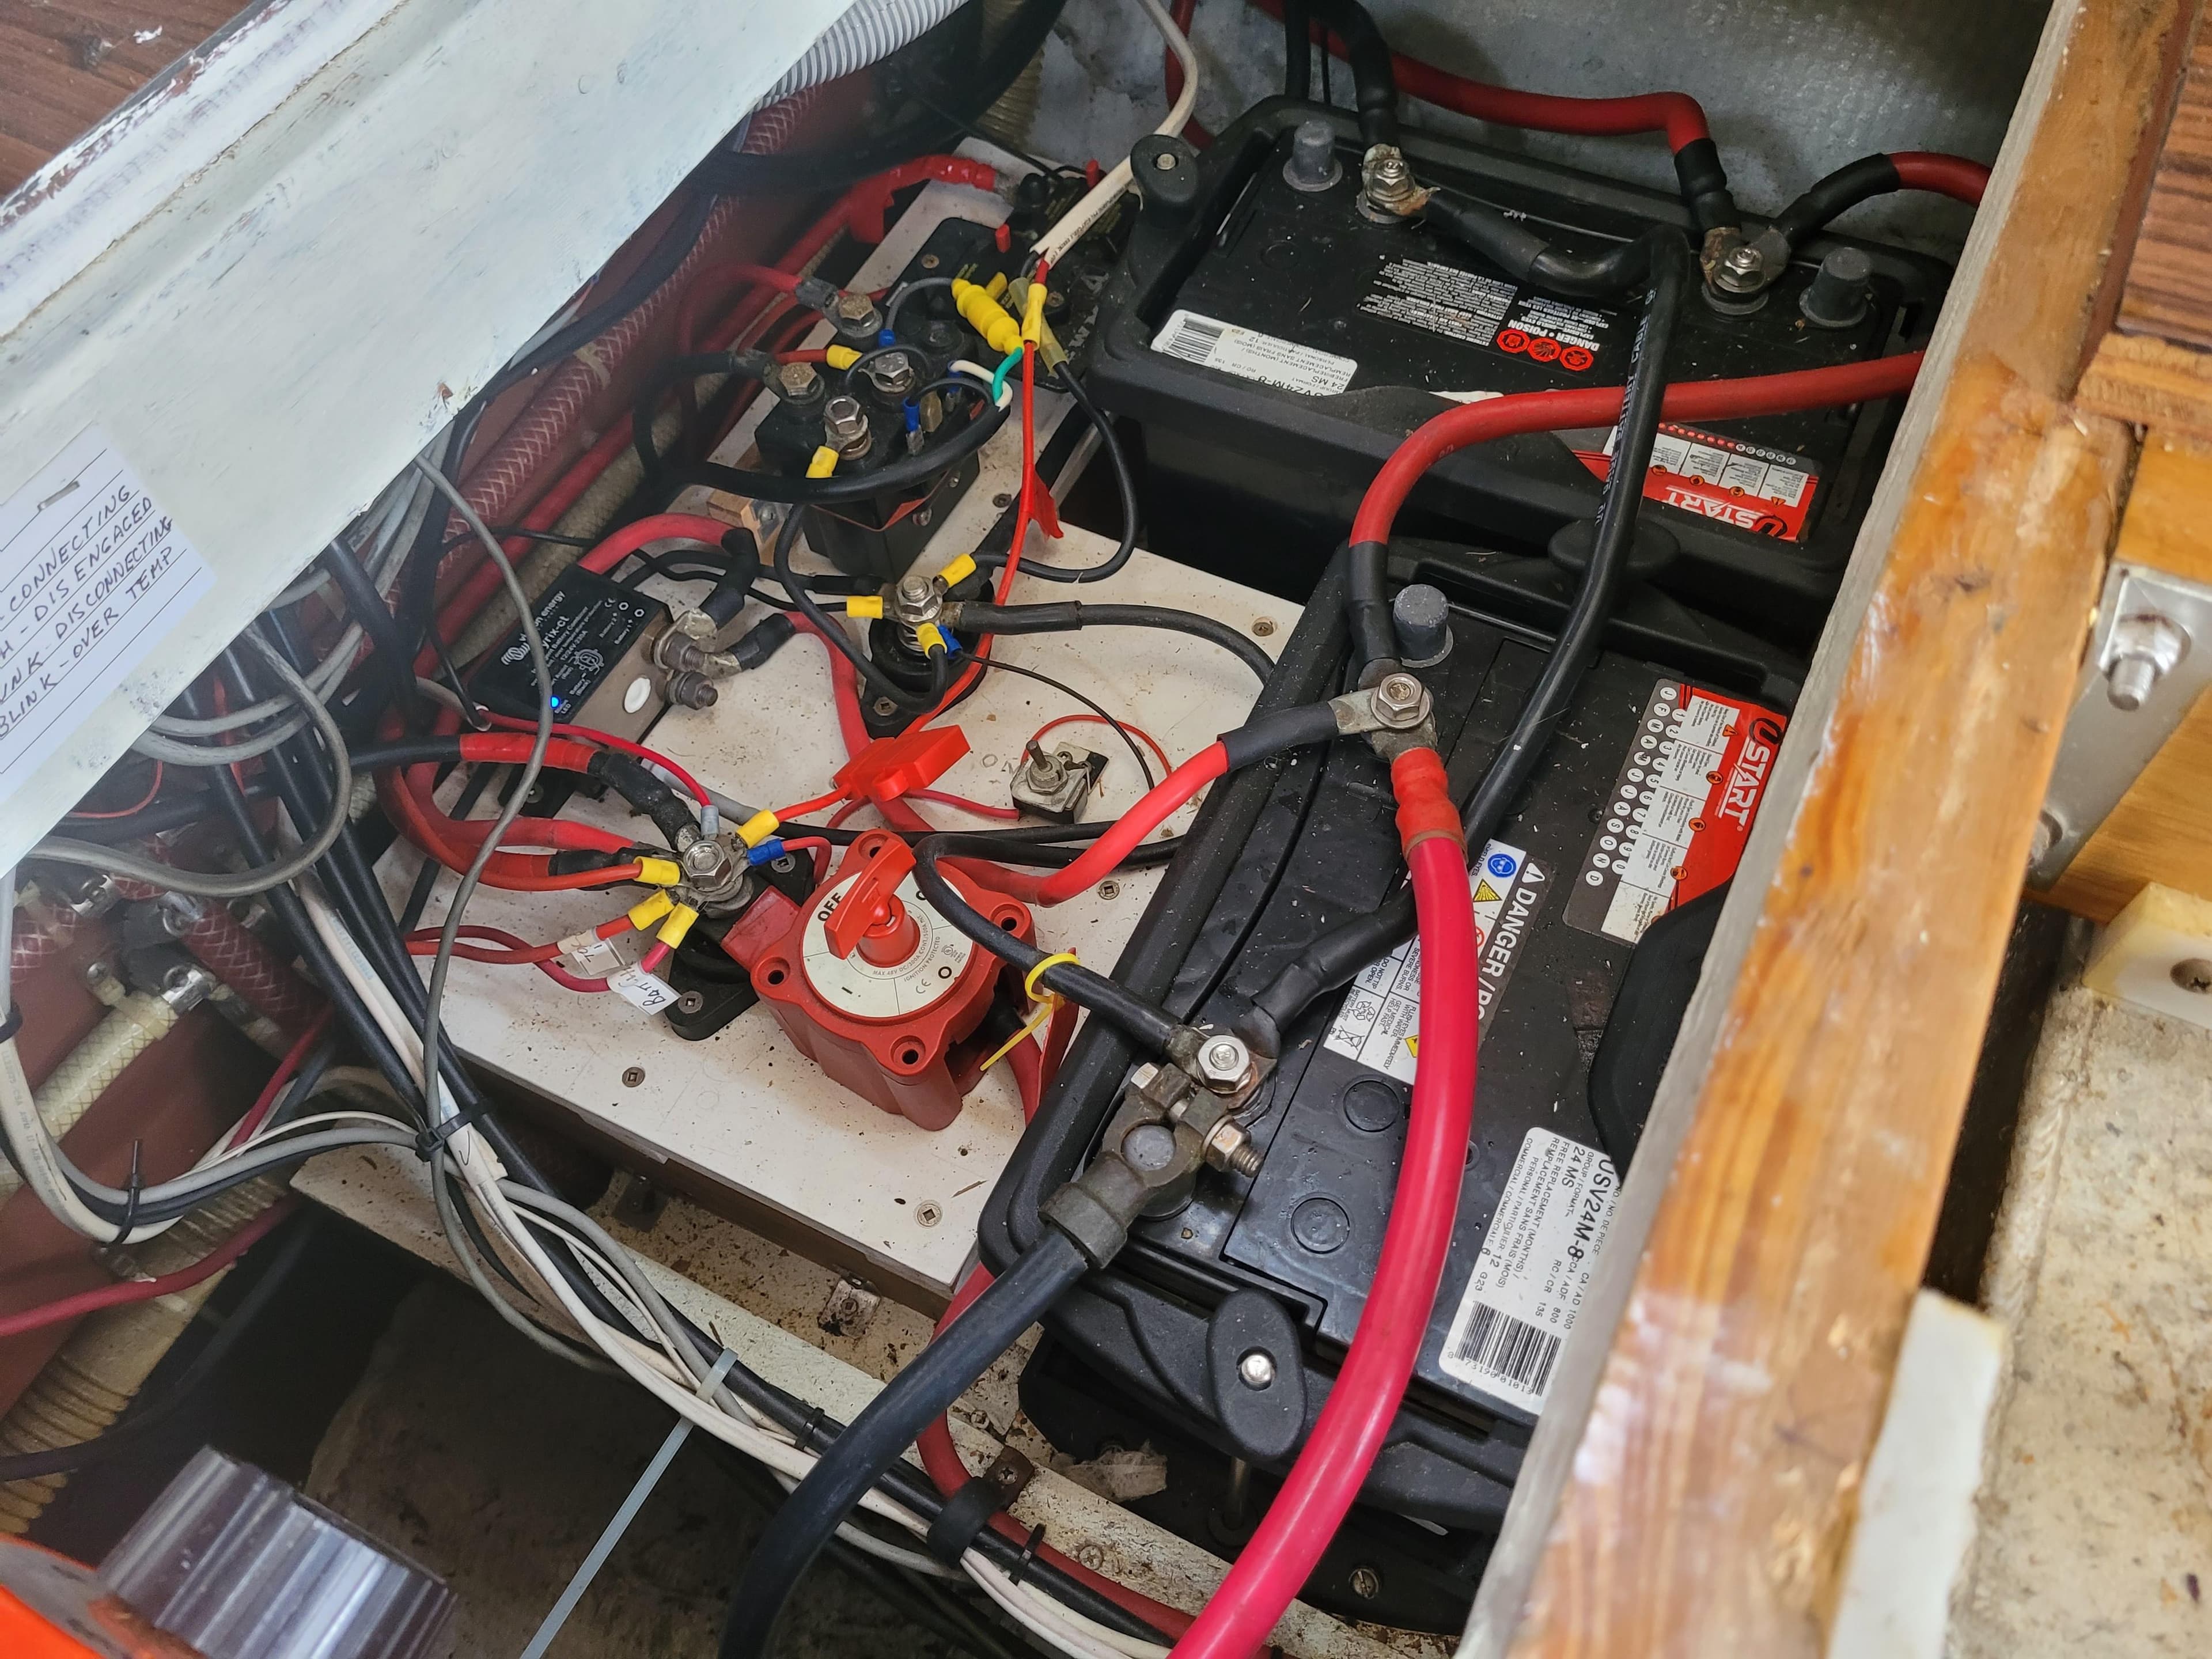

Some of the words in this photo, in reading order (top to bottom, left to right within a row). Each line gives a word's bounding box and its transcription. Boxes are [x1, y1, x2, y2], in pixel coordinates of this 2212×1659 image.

[1508, 319, 1547, 336] POISON
[1630, 314, 1648, 363] CABLE
[1556, 332, 1599, 351] DANGER
[1310, 375, 1328, 385] MS
[1331, 381, 1344, 389] 24
[2, 483, 131, 612] CONNECTING
[51, 514, 175, 638] DISCONNECTING
[31, 580, 71, 621] DIS
[68, 606, 119, 657] OVER
[124, 545, 178, 599] TEMP
[540, 590, 565, 618] energy
[539, 613, 570, 649] yrix-ct
[817, 892, 842, 921] OFF
[1480, 886, 1539, 978] DANGER
[904, 963, 927, 982] IGNITION
[925, 935, 941, 964] PROTECTED
[1380, 957, 1388, 967] DO
[1404, 946, 1420, 971] SEVERE
[1365, 966, 1377, 984] OPEN.
[1370, 979, 1378, 989] TIP
[1374, 967, 1384, 980] NOT
[1395, 969, 1410, 991] BURNS.
[1403, 982, 1411, 991] OR
[1385, 998, 1396, 1012] HELP
[1392, 1000, 1402, 1011] GET
[1400, 1003, 1410, 1018] WITH
[1403, 1006, 1416, 1023] FLUSH
[1390, 1017, 1404, 1039] WATER.
[1397, 1022, 1408, 1037] EYES
[1509, 1138, 1535, 1185] COMMERCIAL
[1555, 1141, 1569, 1164] FREE
[1570, 1146, 1585, 1164] 24
[1525, 1137, 1561, 1206] REMPLACEMENT
[1578, 1151, 1594, 1177] GROUP
[1518, 1157, 1539, 1195] PERSONAL
[1560, 1165, 1579, 1188] MS
[1529, 1165, 1562, 1228] REPLACEMENT
[1518, 1207, 1533, 1230] SANS
[1562, 1158, 1621, 1260] USV24M-8
[1600, 1219, 1609, 1231] DE
[1508, 1233, 1524, 1258] FRAIS
[1512, 1228, 1537, 1272] (MONTHS)
[1590, 1231, 1606, 1255] PIECE
[1489, 1253, 1502, 1267] 12
[1551, 1259, 1561, 1272] RC
[1474, 1271, 1488, 1291] G23
[1495, 1259, 1514, 1288] (MOIS)
[1579, 1272, 1592, 1286] CA
[1543, 1279, 1554, 1293] CR
[1534, 1301, 1546, 1317] 135
[1570, 1291, 1584, 1306] AD
[1548, 1306, 1561, 1323] 800
[1560, 1308, 1576, 1329] 1000
